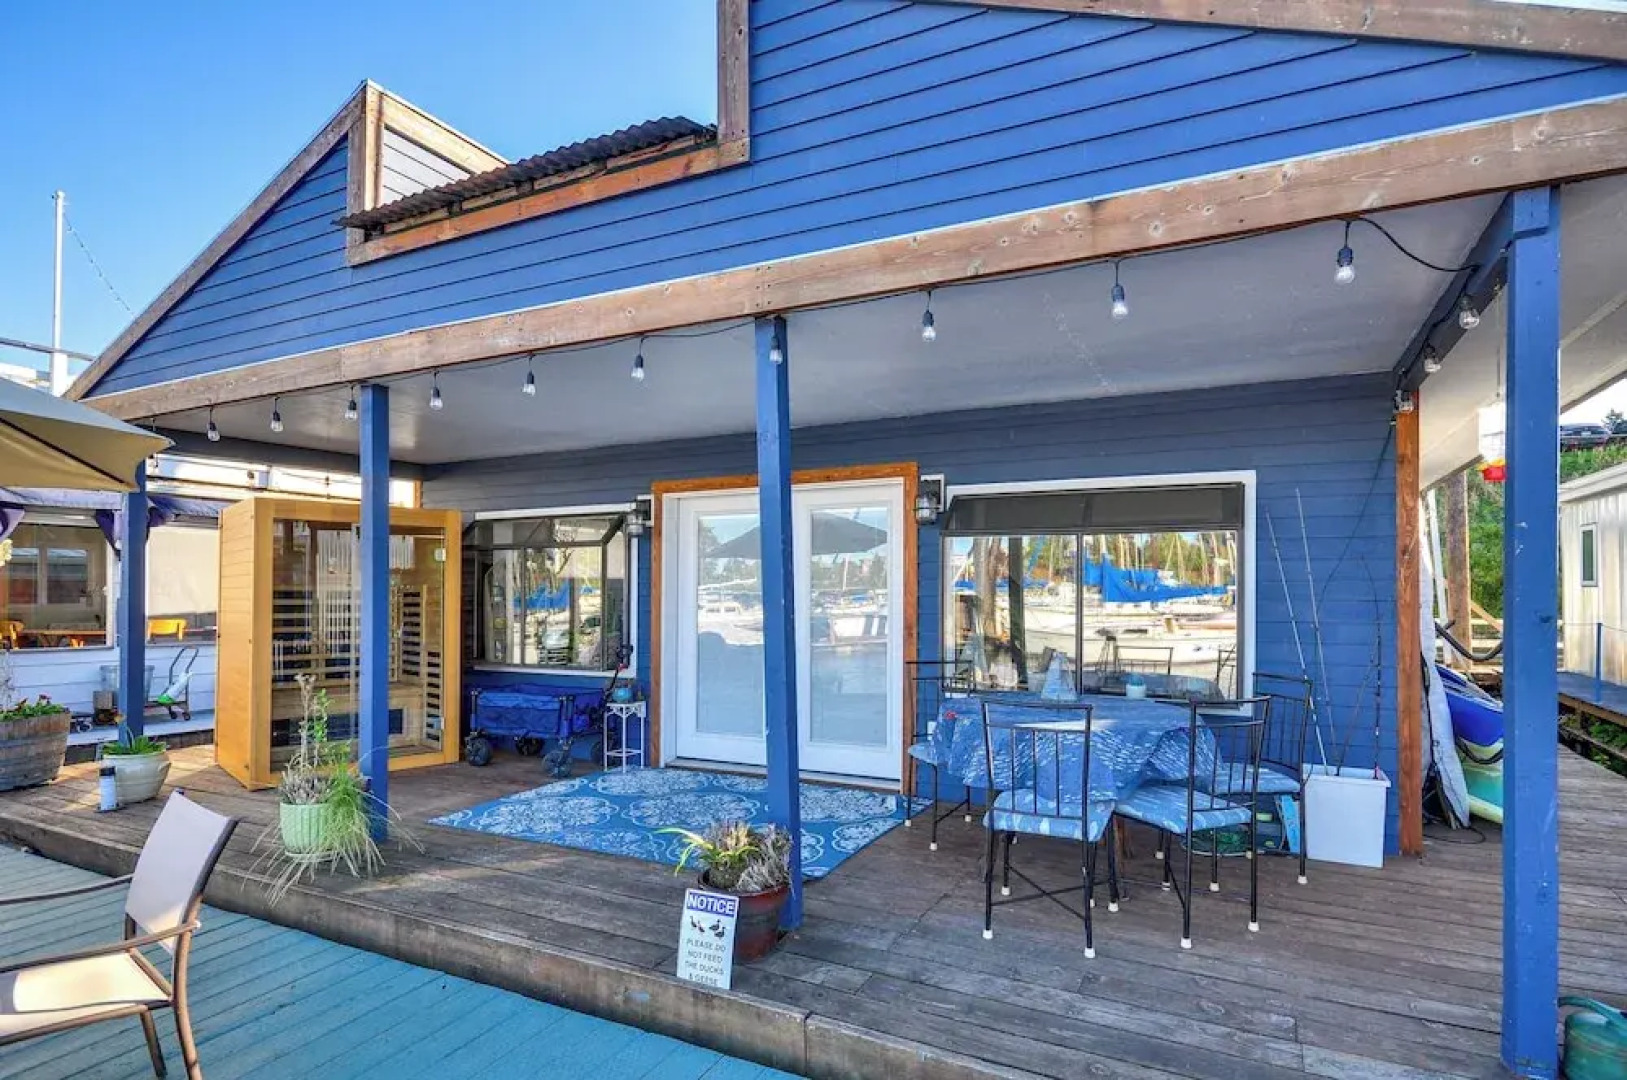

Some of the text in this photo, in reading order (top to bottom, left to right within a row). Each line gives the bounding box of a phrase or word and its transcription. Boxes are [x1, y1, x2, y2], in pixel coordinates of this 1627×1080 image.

[688, 894, 735, 914] NOTICE
[686, 938, 726, 952] PLEASE DO
[687, 950, 723, 963] NOT FEED
